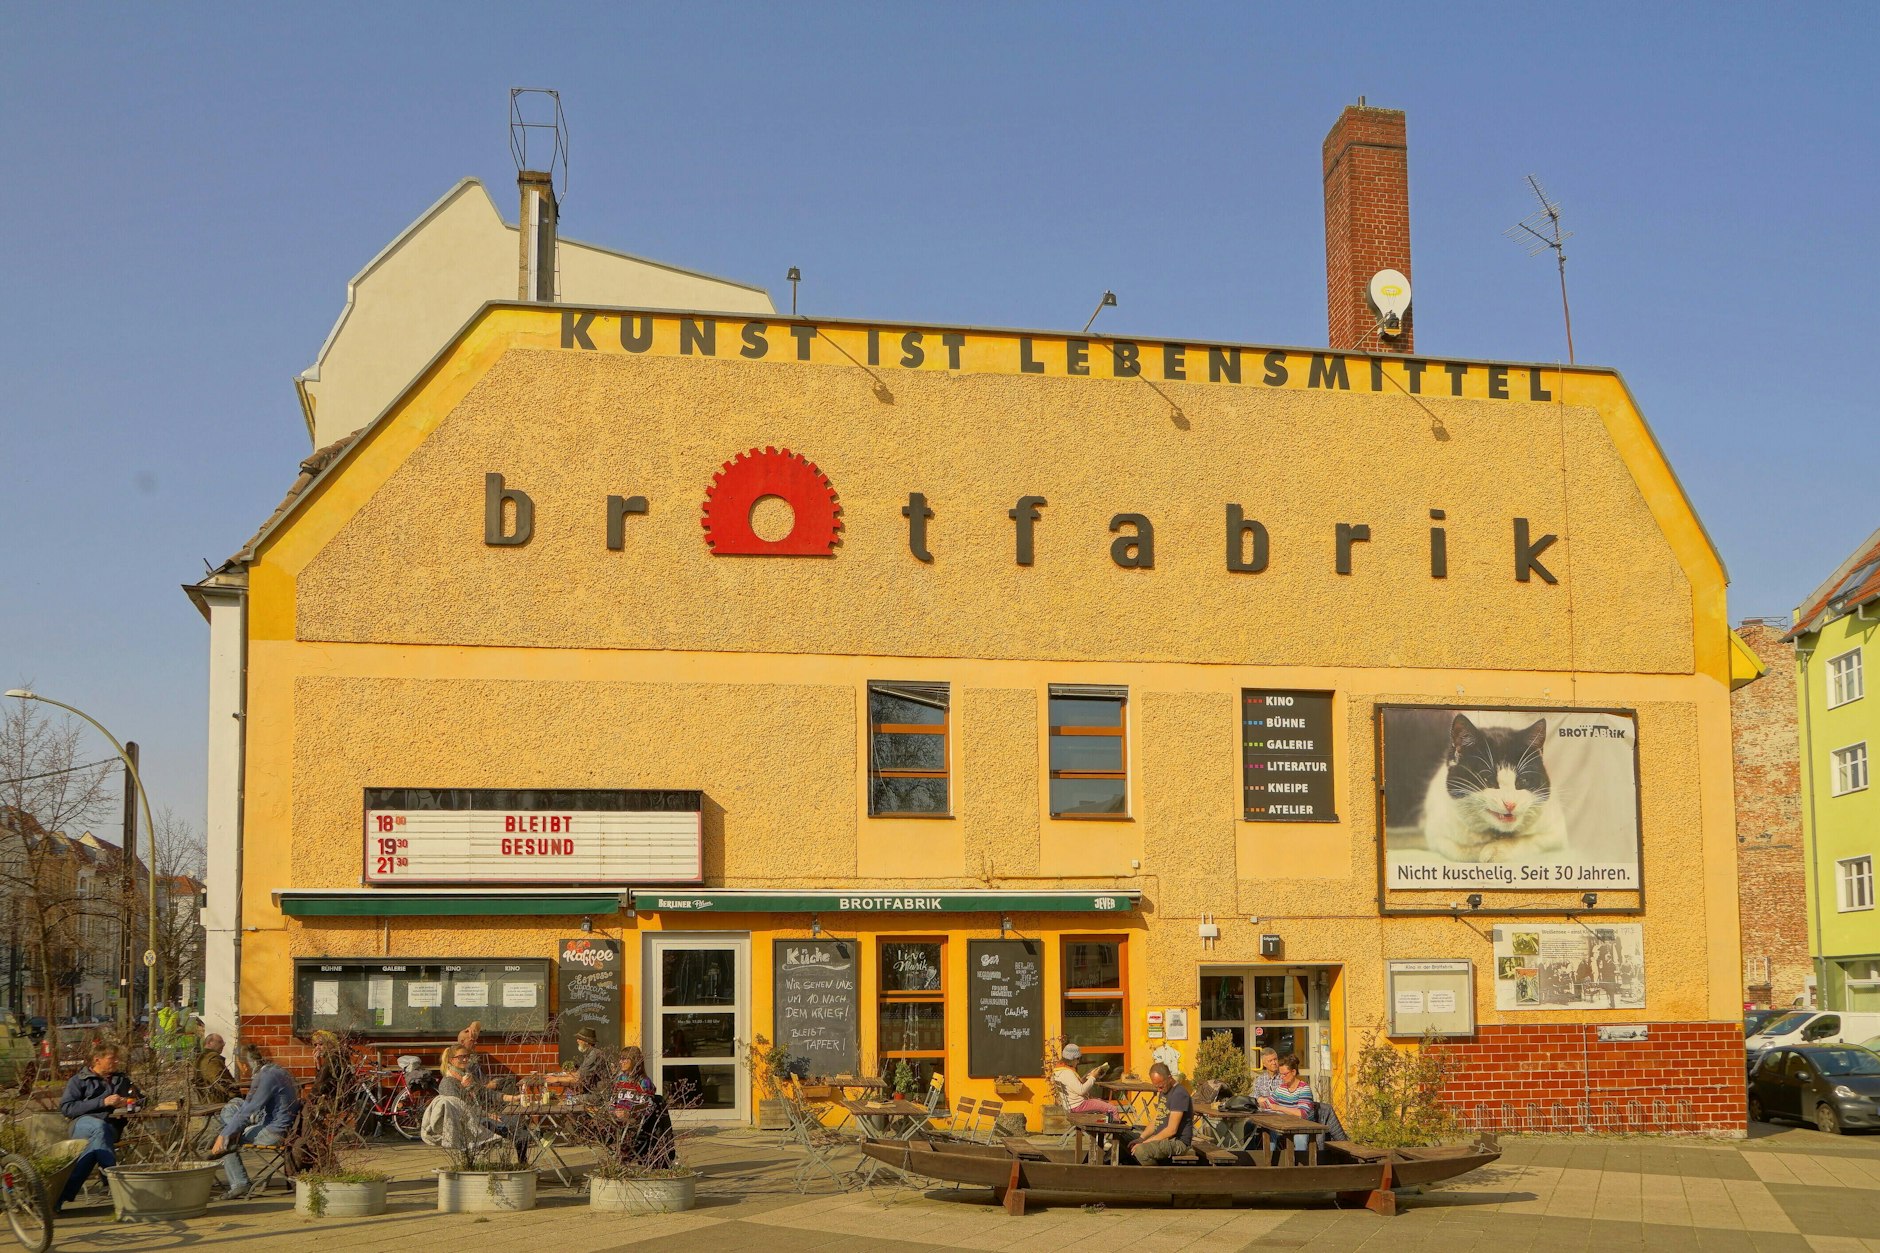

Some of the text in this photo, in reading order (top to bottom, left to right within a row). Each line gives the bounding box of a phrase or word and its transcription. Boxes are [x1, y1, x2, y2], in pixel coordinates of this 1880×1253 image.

[560, 311, 1552, 402] KUNST IST LEBENSMITTEL
[1265, 696, 1294, 706] KINO
[1266, 716, 1305, 728] BÜHNE
[1266, 740, 1314, 750] GALERIE
[1267, 761, 1327, 772] LITERATUR
[1267, 783, 1308, 793] KNEIPE
[1268, 805, 1313, 815] ATELIER
[505, 815, 573, 833] BLEIBT
[501, 838, 574, 855] GESUND
[1398, 865, 1630, 884] Nicht kuschelig. Seit 30 Jahren.
[658, 899, 691, 908] BERLINER
[839, 898, 942, 910] BROTFABRIK
[1094, 897, 1116, 910] JEVER
[1269, 942, 1273, 952] 1
[562, 949, 614, 966] Kaffee
[786, 947, 831, 965] Küche
[803, 980, 833, 989] SEHEN
[836, 980, 853, 990] UNS
[787, 993, 847, 1004] UM 10 NACH
[785, 1005, 849, 1021] DEM KRIEG!
[790, 1027, 825, 1037] BLEIBT
